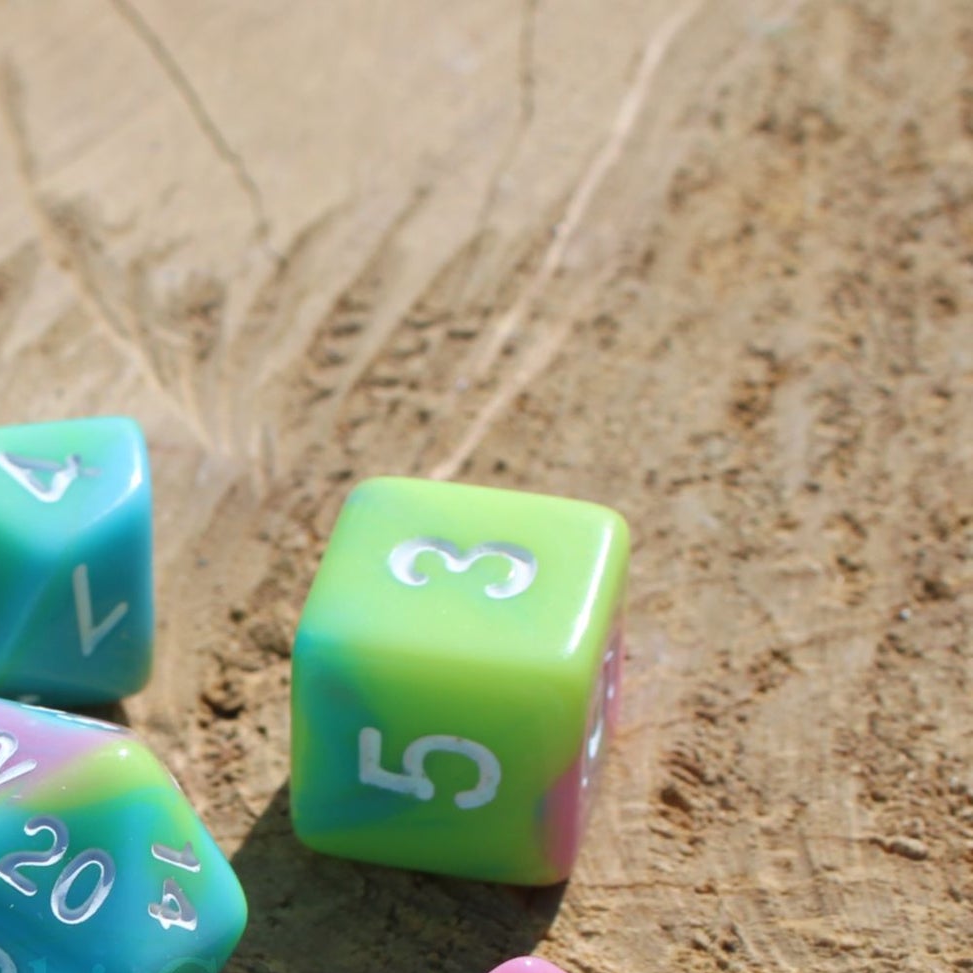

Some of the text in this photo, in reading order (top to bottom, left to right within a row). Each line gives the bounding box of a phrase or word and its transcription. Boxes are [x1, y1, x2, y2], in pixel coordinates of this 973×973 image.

[388, 536, 538, 599] 3
[358, 726, 501, 809] 5
[148, 841, 200, 931] 14
